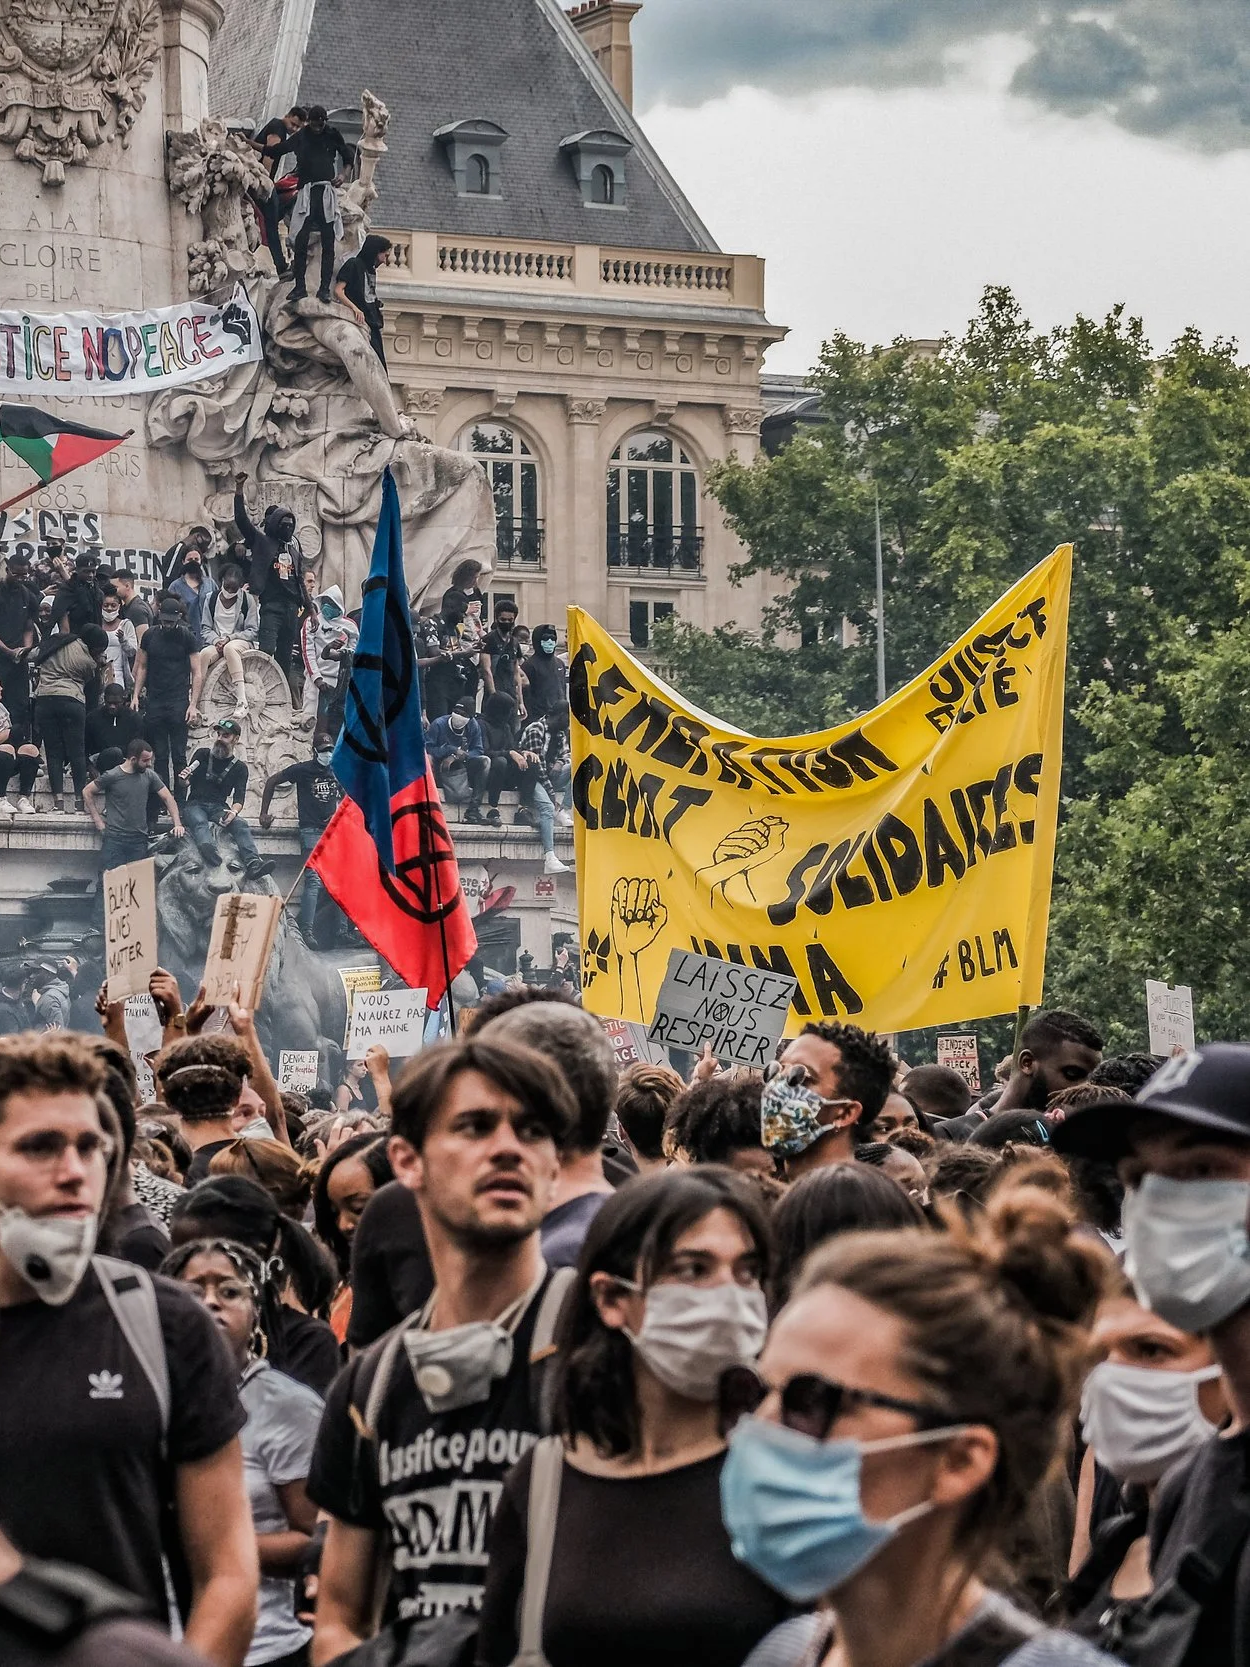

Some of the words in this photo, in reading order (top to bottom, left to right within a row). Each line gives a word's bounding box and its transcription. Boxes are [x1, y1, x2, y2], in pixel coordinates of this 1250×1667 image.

[26, 210, 41, 229] A
[51, 211, 78, 232] LA
[25, 283, 50, 299] DE
[59, 285, 81, 301] LA
[82, 327, 128, 381] NO
[126, 315, 224, 378] PEACE
[109, 878, 140, 914] BLACK
[109, 940, 144, 975] MATTER
[361, 994, 390, 1006] VOUS
[358, 1008, 402, 1022] N'AUREZ
[407, 1007, 426, 1019] PAS
[694, 996, 763, 1031] NOUS
[355, 1026, 372, 1037] MA
[379, 1023, 409, 1035] HAINE
[282, 1074, 292, 1084] OF
